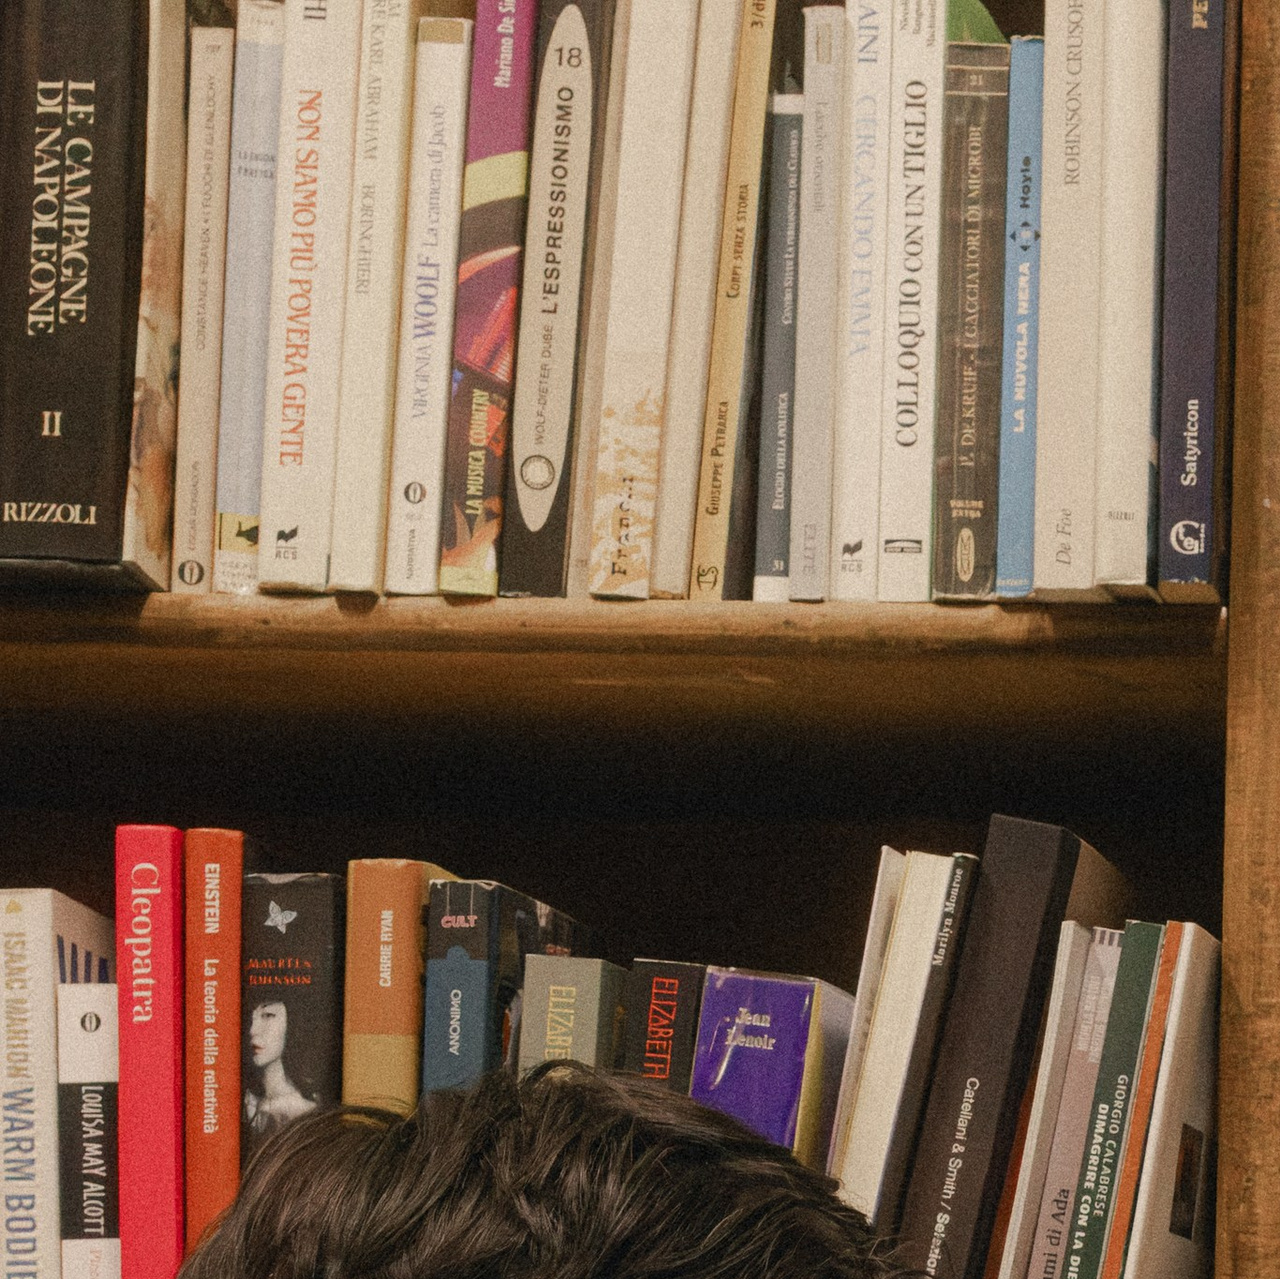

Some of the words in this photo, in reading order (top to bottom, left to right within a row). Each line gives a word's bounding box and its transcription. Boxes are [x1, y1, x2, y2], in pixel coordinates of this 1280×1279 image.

[368, 24, 385, 65] KARL
[555, 47, 582, 68] 18
[35, 79, 63, 114] DI
[66, 79, 94, 126] LE
[295, 88, 322, 141] NON
[362, 76, 381, 160] ABRAHAM
[428, 104, 448, 147] Jacob
[902, 80, 928, 178] TIGLIO
[1063, 81, 1082, 184] ROBINSON
[428, 149, 443, 162] di
[849, 94, 879, 258] CERCANDO
[1018, 155, 1033, 208] Hoyle
[291, 148, 319, 227] SIAMO
[425, 167, 443, 224] camera
[541, 86, 574, 314] L'ESPRESSIONISMO
[904, 184, 924, 217] UN
[28, 126, 61, 336] NAPOLEONE
[59, 137, 92, 324] CAMPAGNE
[288, 232, 319, 271] PIÙ
[354, 184, 376, 295] BORINGHIERI
[423, 227, 439, 246] La
[903, 224, 923, 272] CON
[412, 252, 440, 340] WOOLF
[848, 269, 873, 357] EMMA
[1016, 261, 1030, 314] NERA
[283, 278, 312, 377] POVERA
[541, 324, 553, 358] DUBE
[412, 344, 431, 419] VIRGINIA
[894, 278, 926, 447] COLLOQUIO
[1013, 321, 1029, 400] NUVOLA
[278, 383, 307, 466] GENTE
[468, 388, 491, 446] COUNTRY
[534, 363, 550, 445] WOLF-DIETER
[1012, 408, 1025, 432] LA
[1180, 398, 1202, 486] Satyricon
[464, 448, 486, 495] MUSICA
[3, 500, 96, 526] RIZZOLI
[464, 498, 482, 514] LA
[1055, 508, 1072, 536] Foe
[1055, 542, 1071, 565] De
[204, 862, 219, 933] EINSTEIN
[441, 915, 477, 927] CULT
[931, 916, 955, 966] Marilyn
[943, 866, 963, 913] Monroe
[122, 862, 161, 1023] Cleopatra
[380, 909, 392, 941] RYAN
[3, 932, 26, 989] ISAAC
[204, 959, 218, 975] La
[379, 944, 391, 986] CARRIE
[204, 981, 218, 1023] teoria
[448, 989, 461, 1055] ANONIMO
[641, 976, 679, 1079] ELIZABETH
[734, 1006, 772, 1027] Jean
[5, 998, 28, 1078] MARION
[203, 1028, 218, 1065] della
[724, 1029, 776, 1050] Lenoir
[80, 1085, 103, 1138] LOUISA
[202, 1069, 218, 1133] relatività
[953, 1076, 980, 1141] Catellani
[1107, 1073, 1129, 1134] GIORGIO
[1, 1087, 36, 1181] WARM
[81, 1142, 106, 1176] MAY
[950, 1142, 965, 1154] &
[1083, 1102, 1109, 1189] DIMAGRIRE
[940, 1156, 962, 1200] Smith
[1048, 1186, 1071, 1223] Ada
[1092, 1139, 1116, 1217] CALABRESE
[82, 1181, 104, 1235] ALCOTT
[1076, 1194, 1093, 1226] CON
[1044, 1227, 1062, 1247] di
[1071, 1231, 1086, 1250] LA
